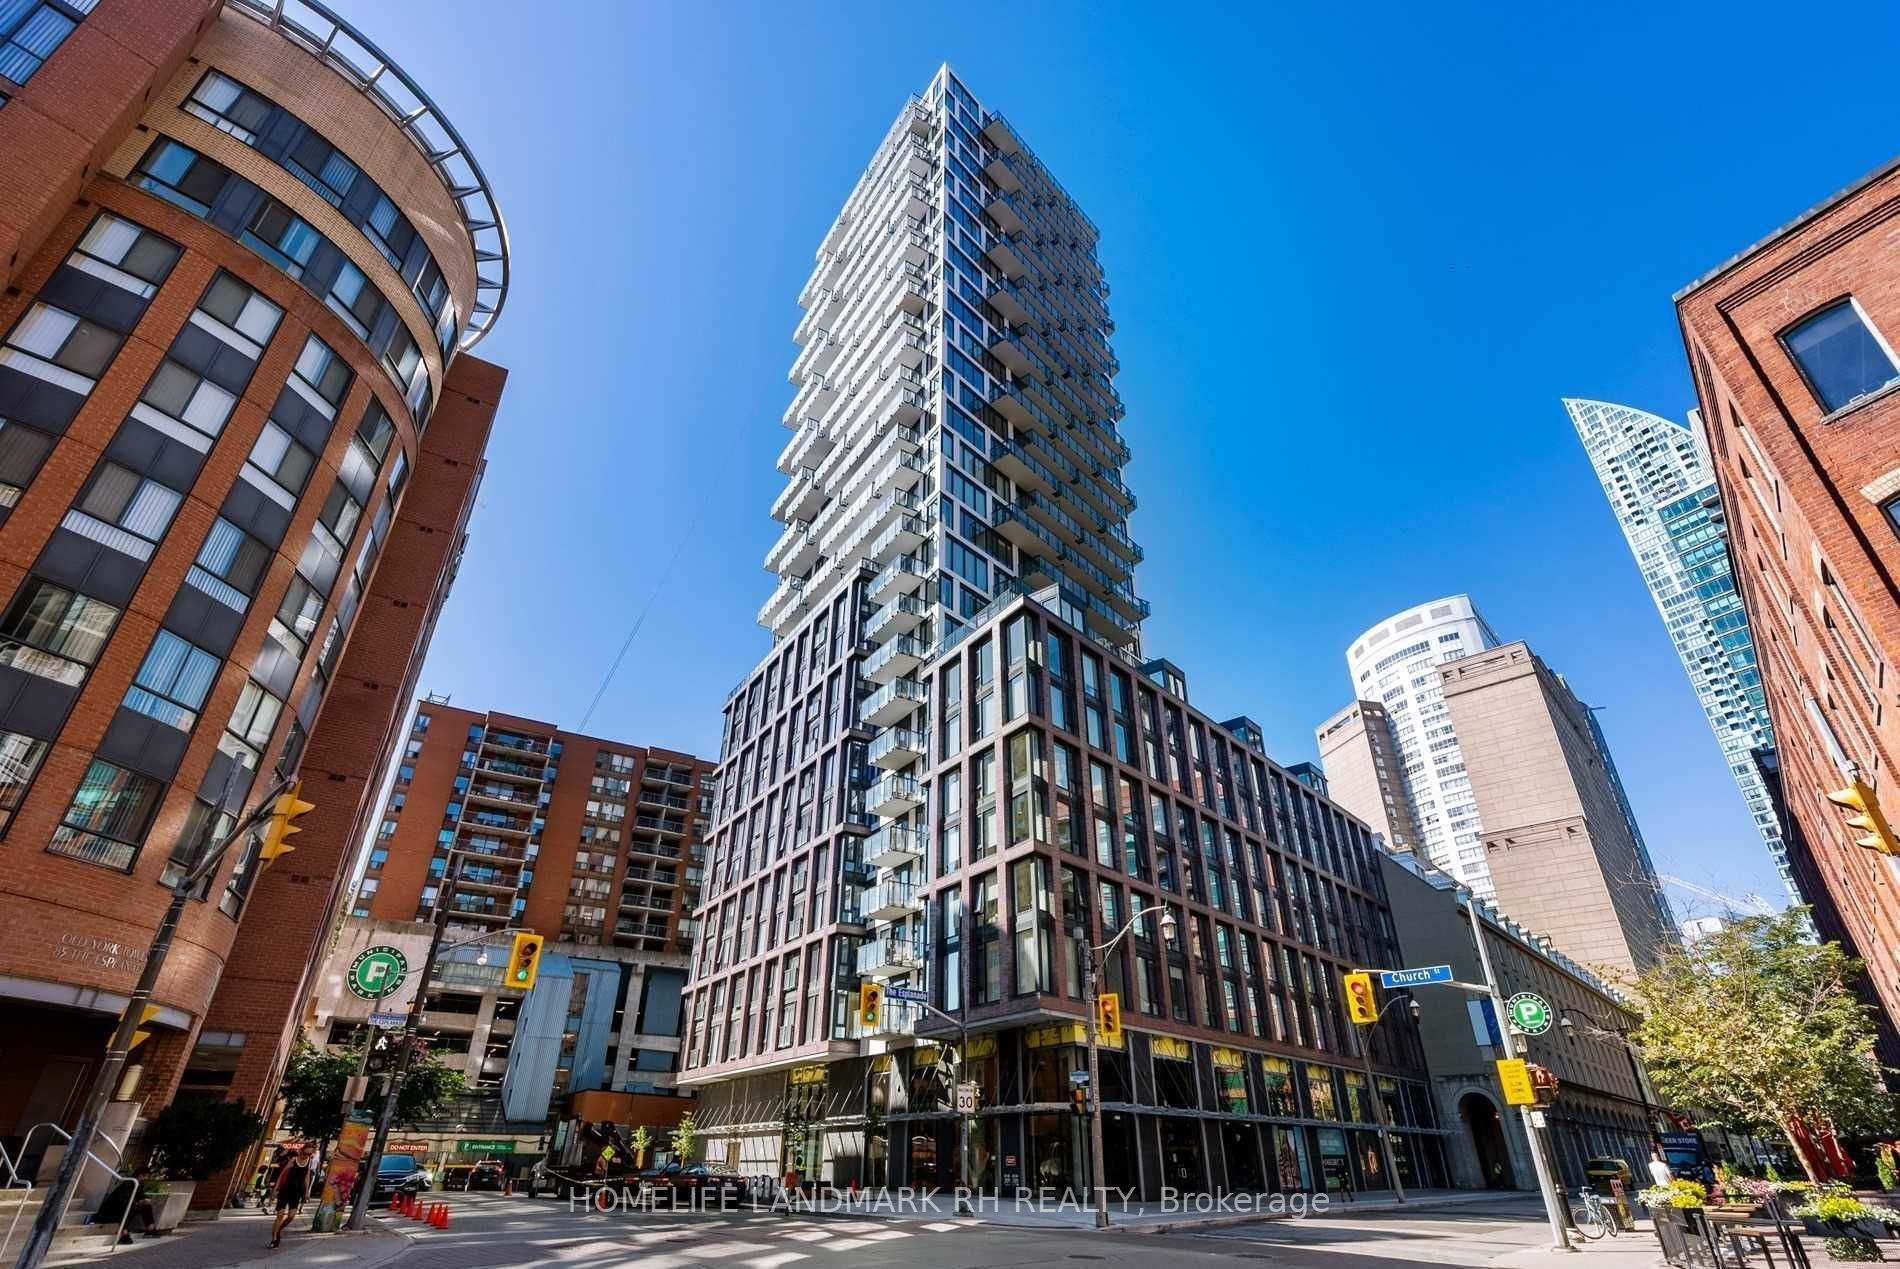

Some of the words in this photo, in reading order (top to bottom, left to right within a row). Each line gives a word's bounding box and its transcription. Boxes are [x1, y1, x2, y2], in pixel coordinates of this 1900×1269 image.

[92, 939, 121, 955] YORK
[352, 947, 407, 973] MUNICIPAL
[1391, 969, 1431, 983] Church
[350, 975, 402, 999] PARKNG
[886, 987, 897, 997] The
[898, 989, 927, 1001] Esplanade
[1519, 1002, 1538, 1021] P
[959, 1096, 973, 1108] 30
[1677, 1137, 1697, 1145] STORE
